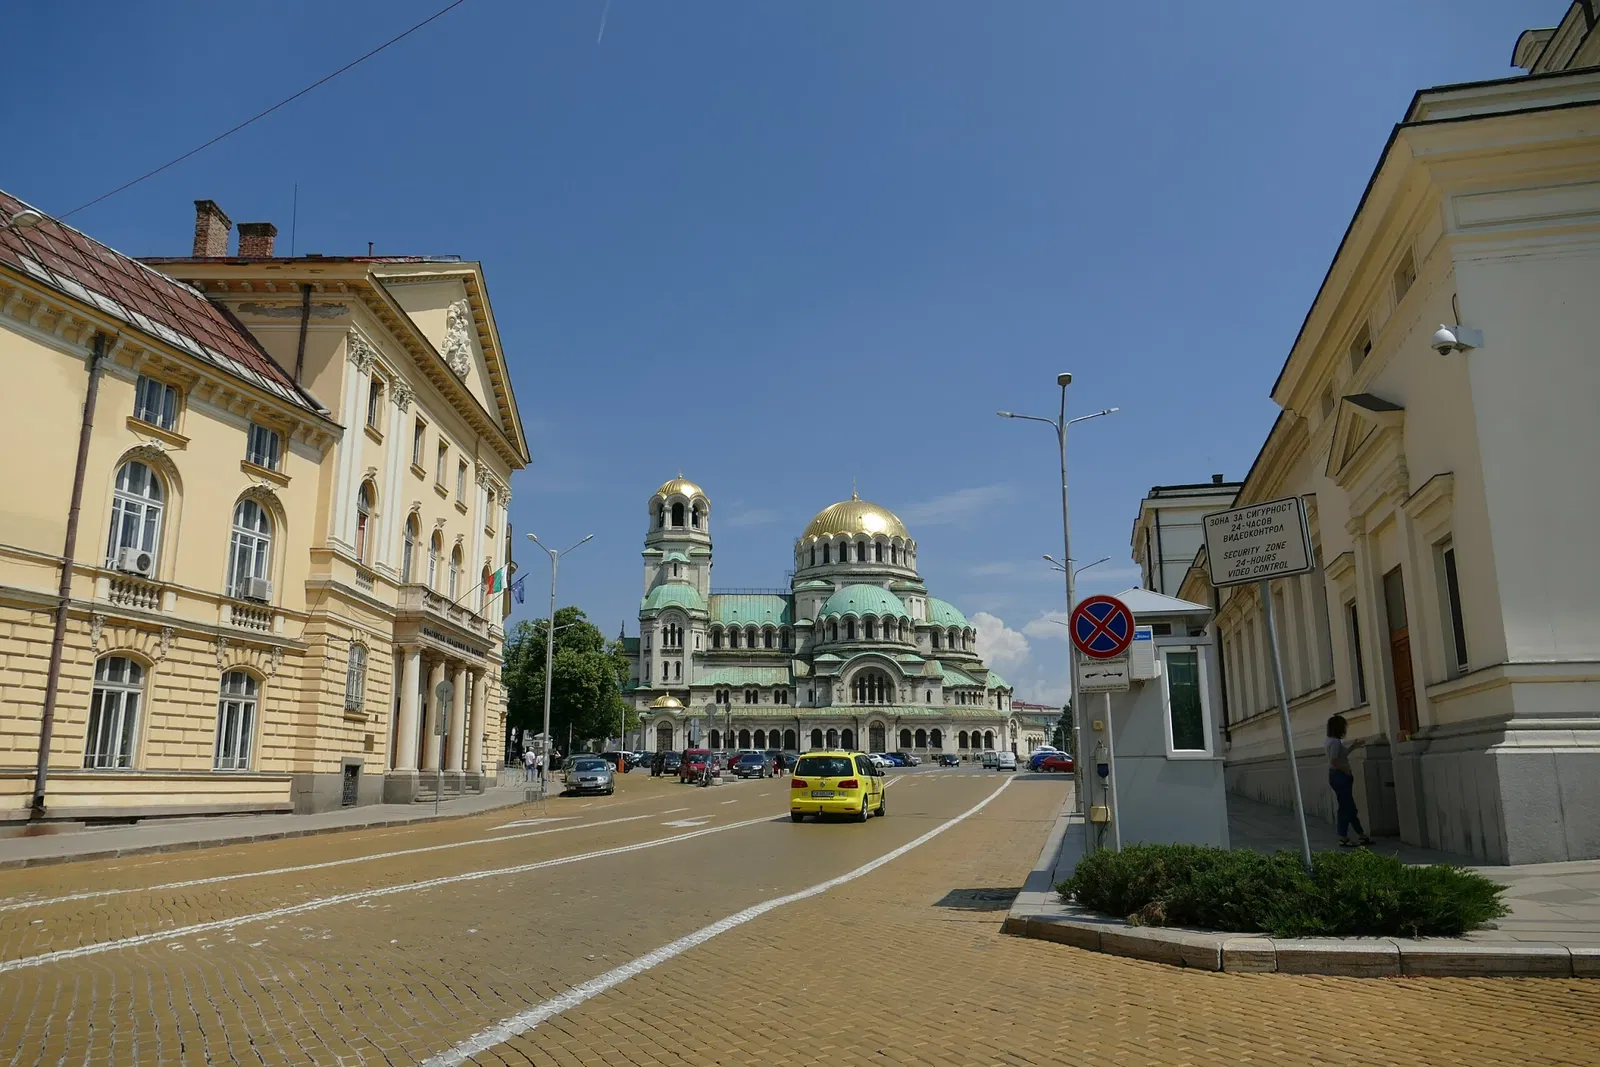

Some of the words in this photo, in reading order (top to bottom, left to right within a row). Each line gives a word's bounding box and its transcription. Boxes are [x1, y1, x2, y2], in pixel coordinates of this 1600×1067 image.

[1210, 517, 1229, 527] ЗОНА
[1234, 514, 1243, 522] ЗА
[1247, 503, 1293, 519] СИГУРНОСТ
[1223, 524, 1284, 543] ВИДЕОКОНТРОЛ
[1231, 517, 1272, 532] 24-ЧАСОВ
[1223, 546, 1260, 560] SECURITY
[1265, 541, 1287, 552] ZONE
[1228, 568, 1250, 578] VIDEO
[1253, 561, 1289, 574] CONTROL
[1235, 553, 1277, 568] 24-HOURS
